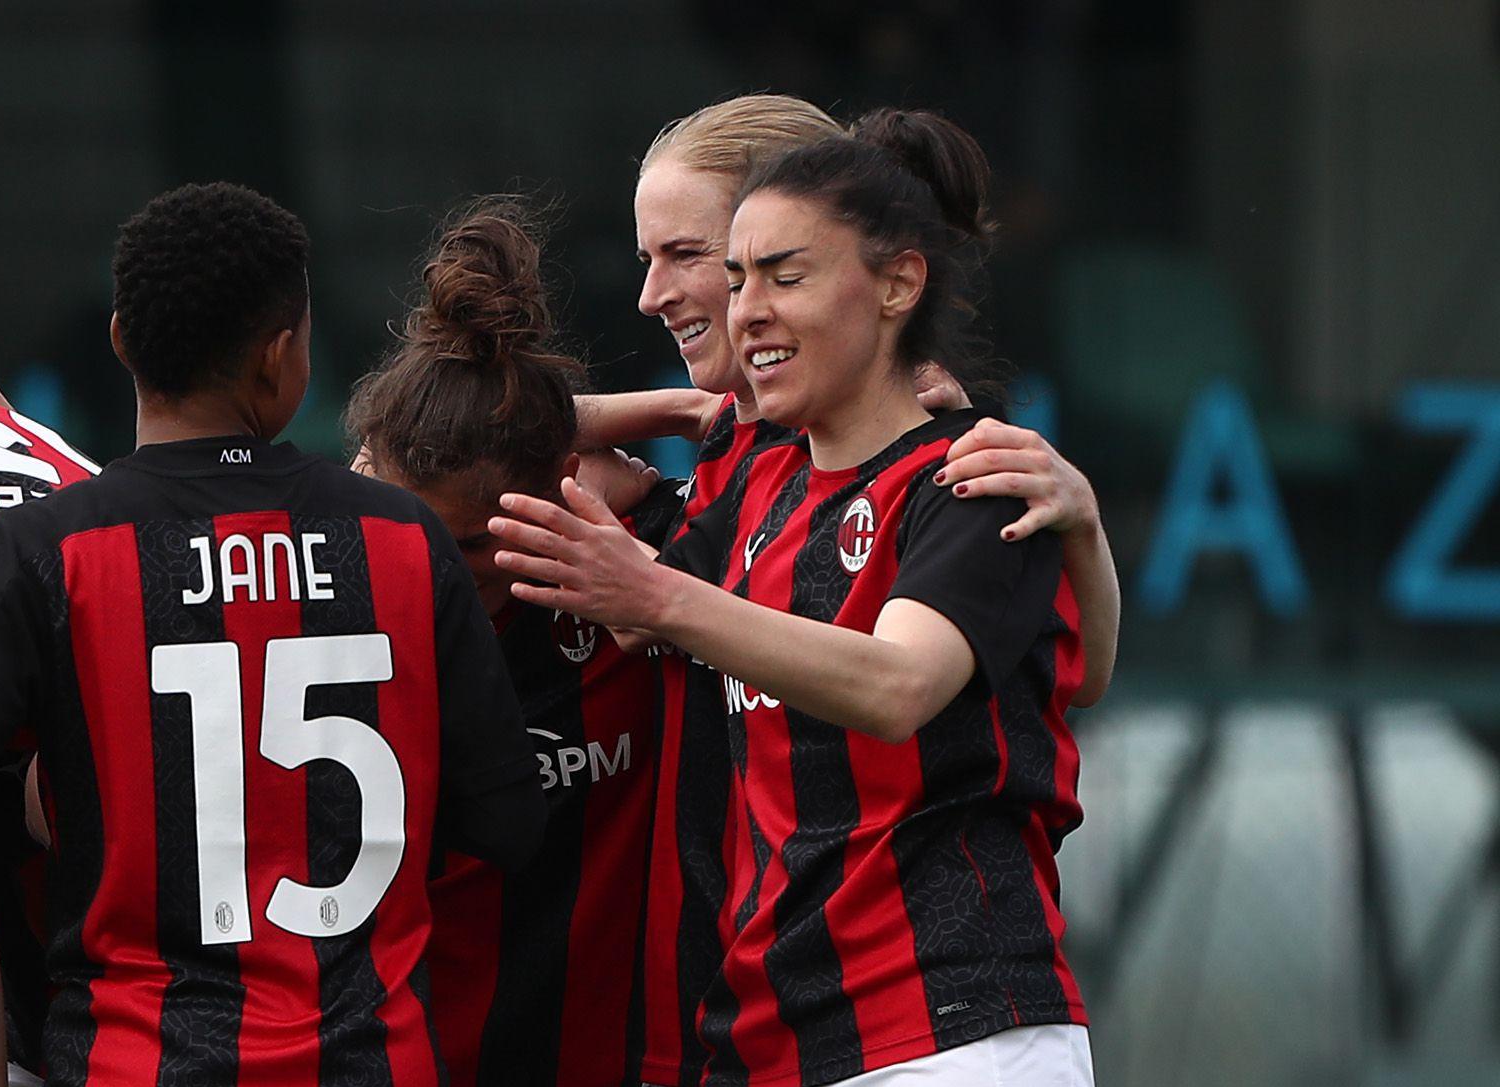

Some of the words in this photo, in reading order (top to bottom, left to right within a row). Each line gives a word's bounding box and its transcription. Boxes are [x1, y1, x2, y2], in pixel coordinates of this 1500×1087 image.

[220, 448, 252, 463] ACM
[182, 532, 335, 604] JANE
[151, 633, 404, 945] 15
[535, 732, 632, 790] BPM
